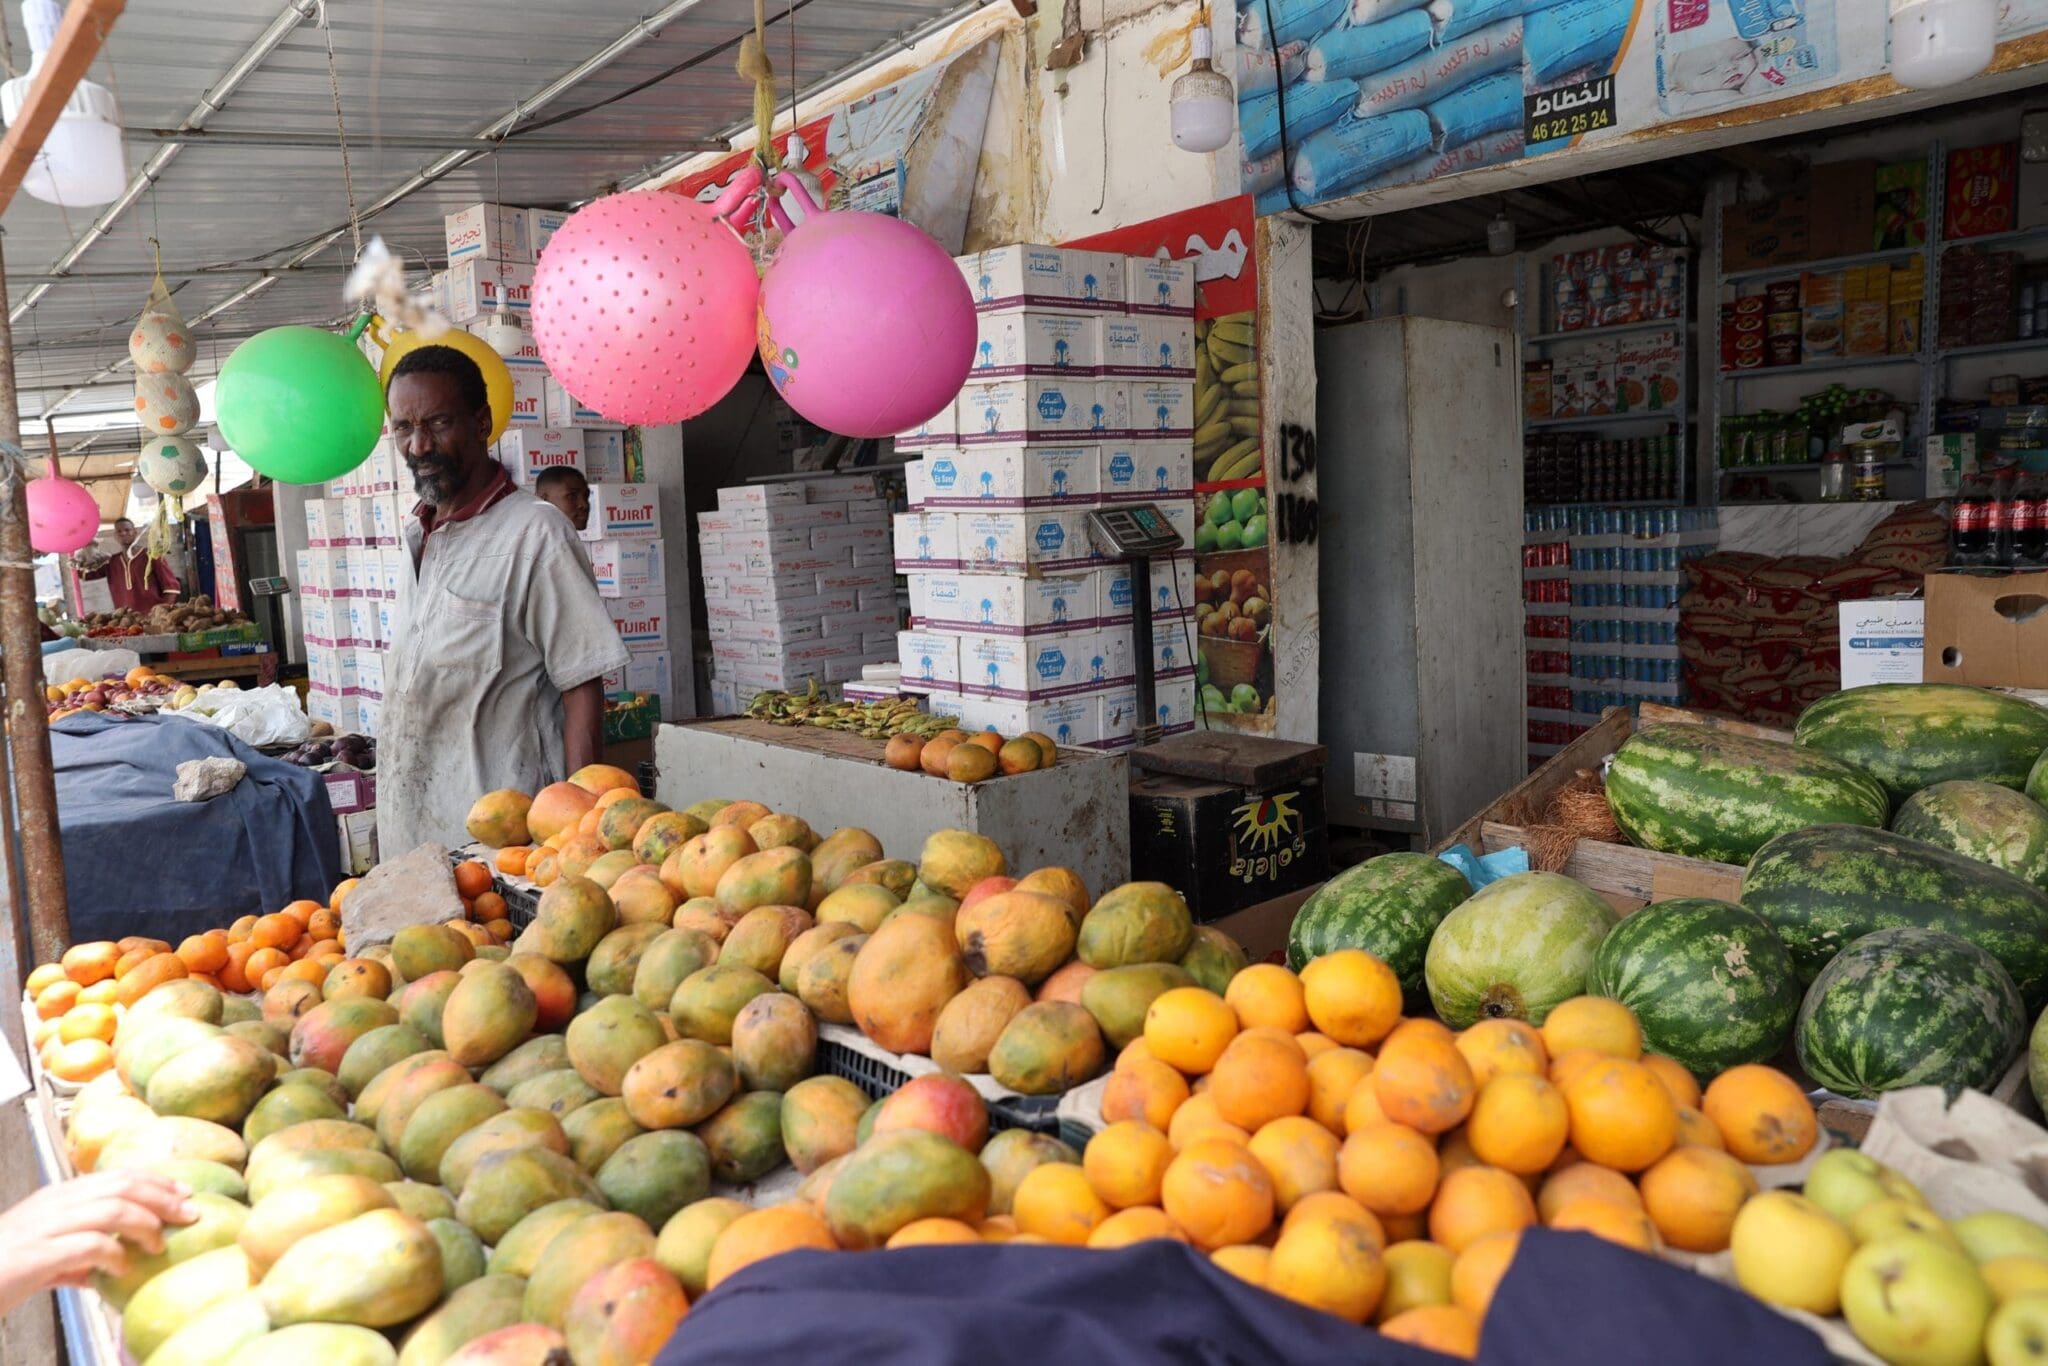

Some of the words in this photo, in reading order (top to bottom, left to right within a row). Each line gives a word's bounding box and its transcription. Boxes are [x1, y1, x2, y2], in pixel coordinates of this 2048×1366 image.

[1531, 79, 1610, 118] الخطاط
[1532, 122, 1548, 141] 46
[1551, 118, 1568, 137] 22
[1571, 113, 1588, 133] 25
[1591, 108, 1608, 129] 24
[529, 450, 579, 466] TIJIRIT
[606, 504, 654, 522] TIJIRIT
[615, 616, 661, 634] TIJIRIT
